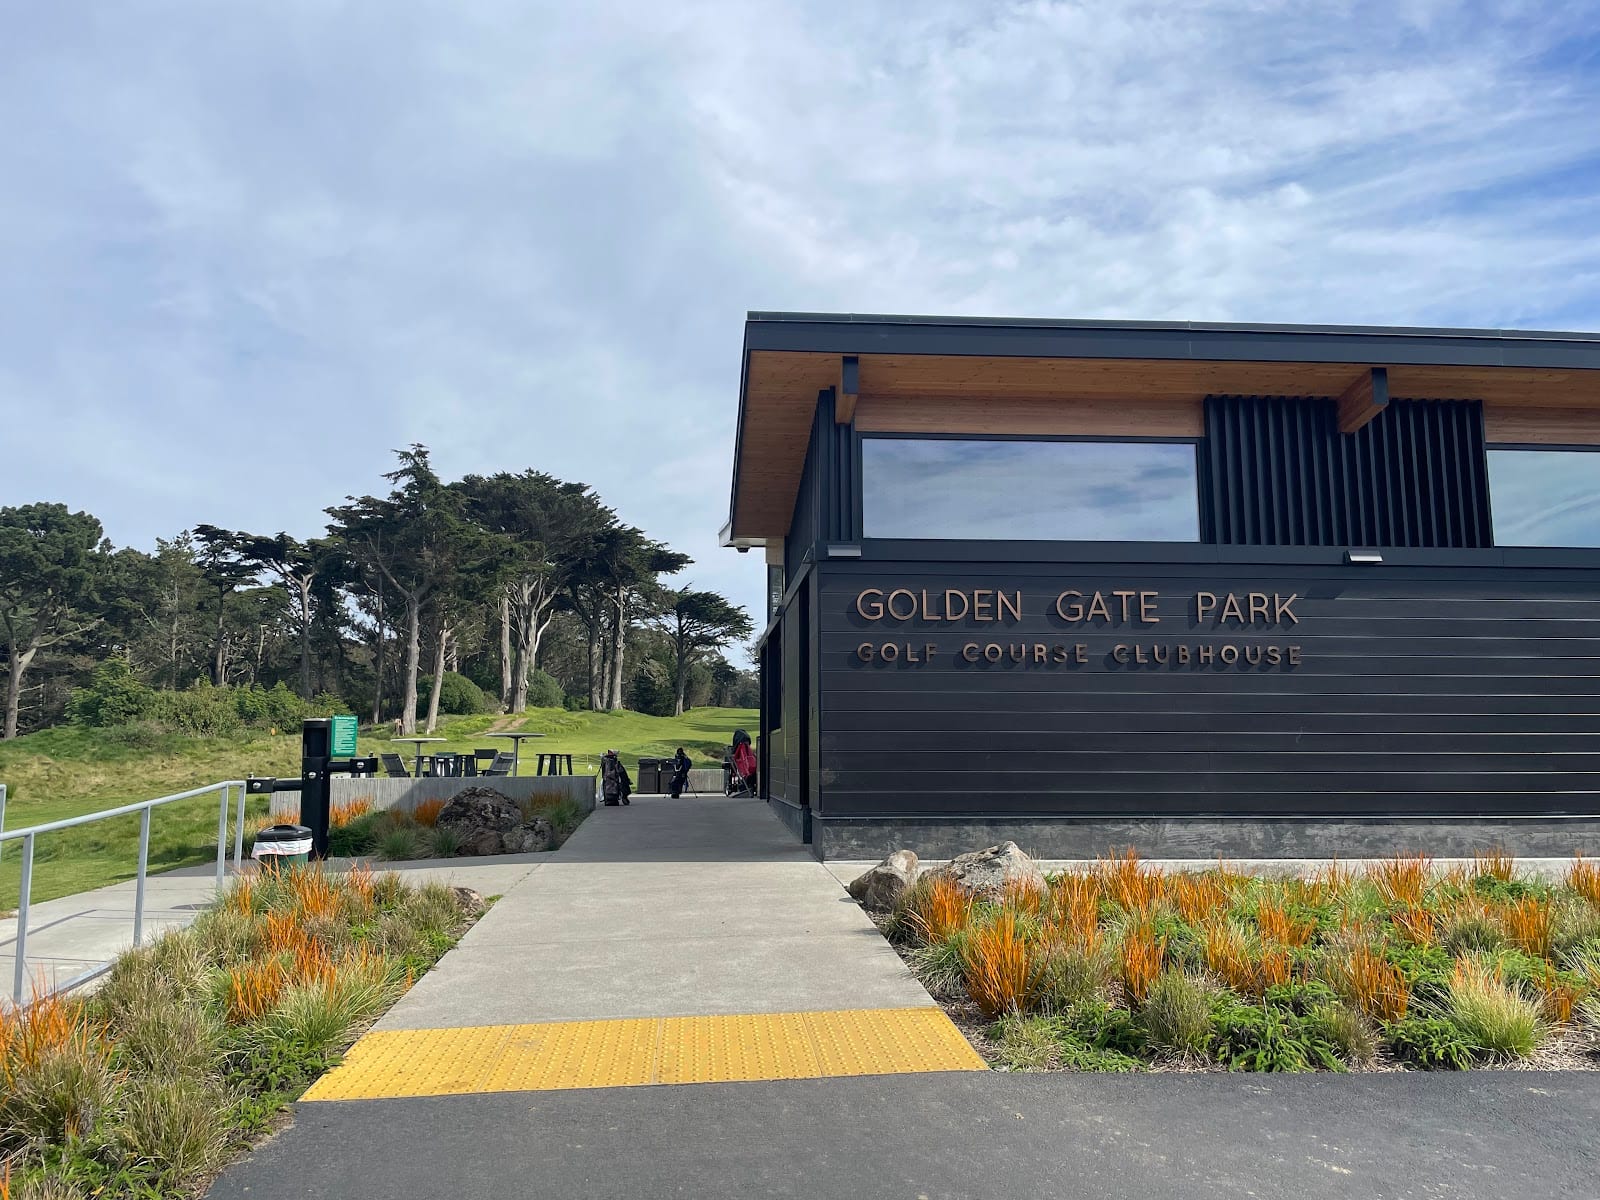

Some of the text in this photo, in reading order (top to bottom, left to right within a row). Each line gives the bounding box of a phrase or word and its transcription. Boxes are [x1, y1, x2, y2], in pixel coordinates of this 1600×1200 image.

[856, 588, 1299, 625] GOLDEN GATE PARK
[856, 641, 1302, 665] GOLF COURSE CLUBHOUSE
